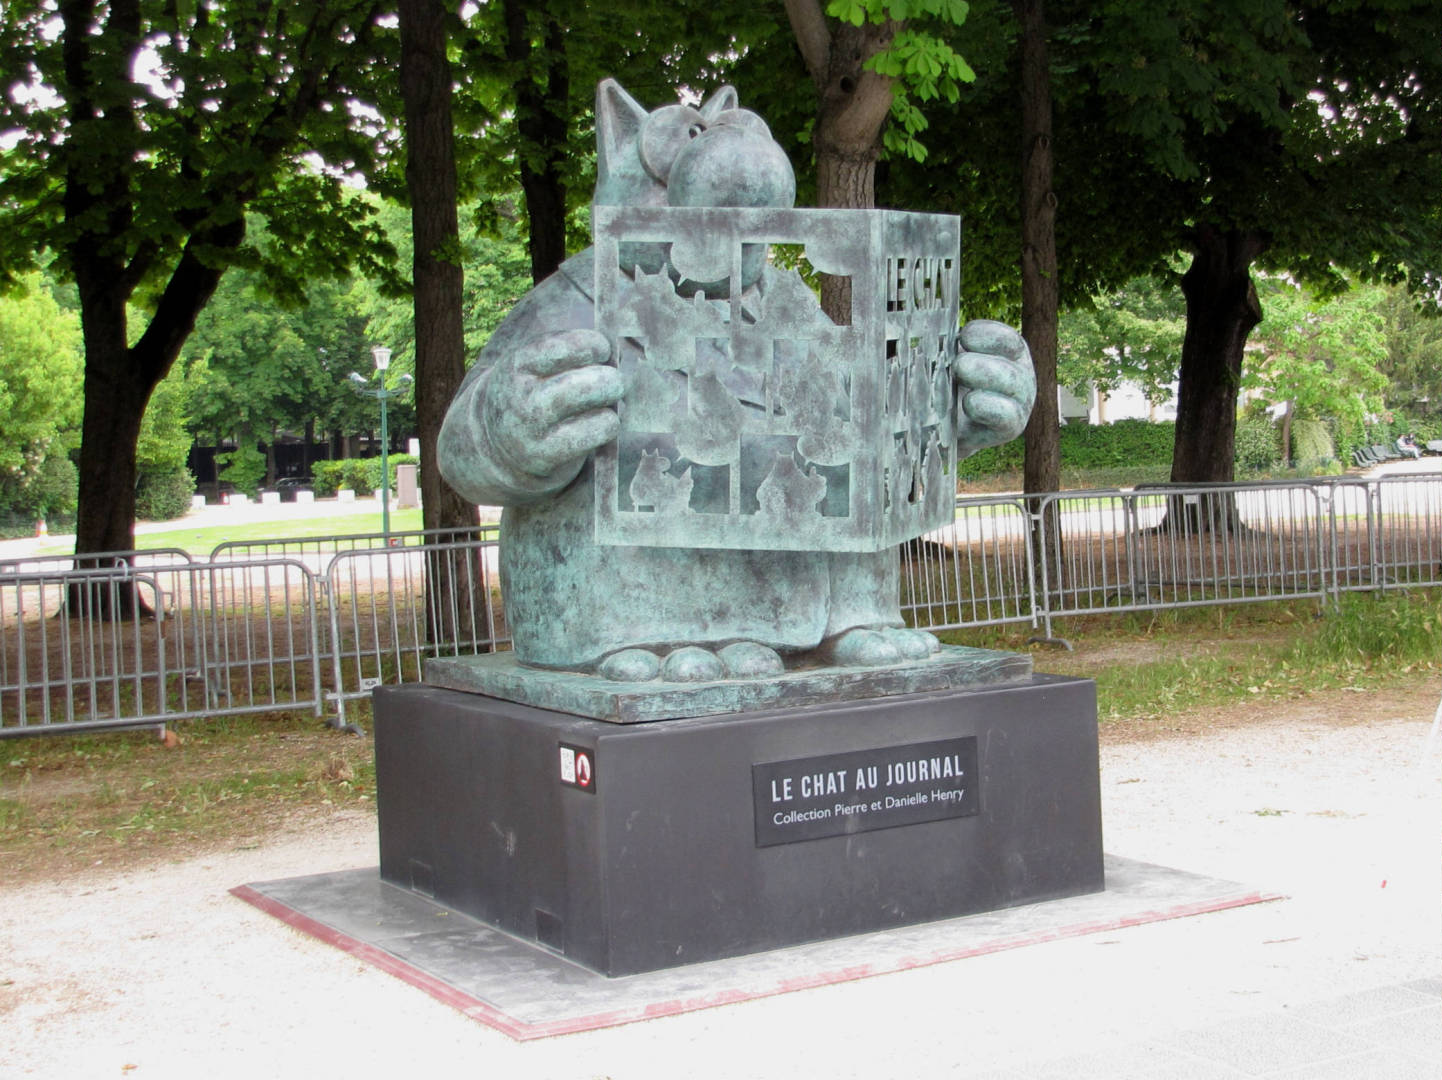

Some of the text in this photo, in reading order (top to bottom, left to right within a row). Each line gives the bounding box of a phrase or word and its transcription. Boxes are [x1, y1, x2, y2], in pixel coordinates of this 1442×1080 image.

[886, 257, 954, 312] LE CHAT
[771, 755, 964, 802] LE CHAT AU JOURNAL
[773, 788, 964, 825] Collection Pierre et Danielle Henry
